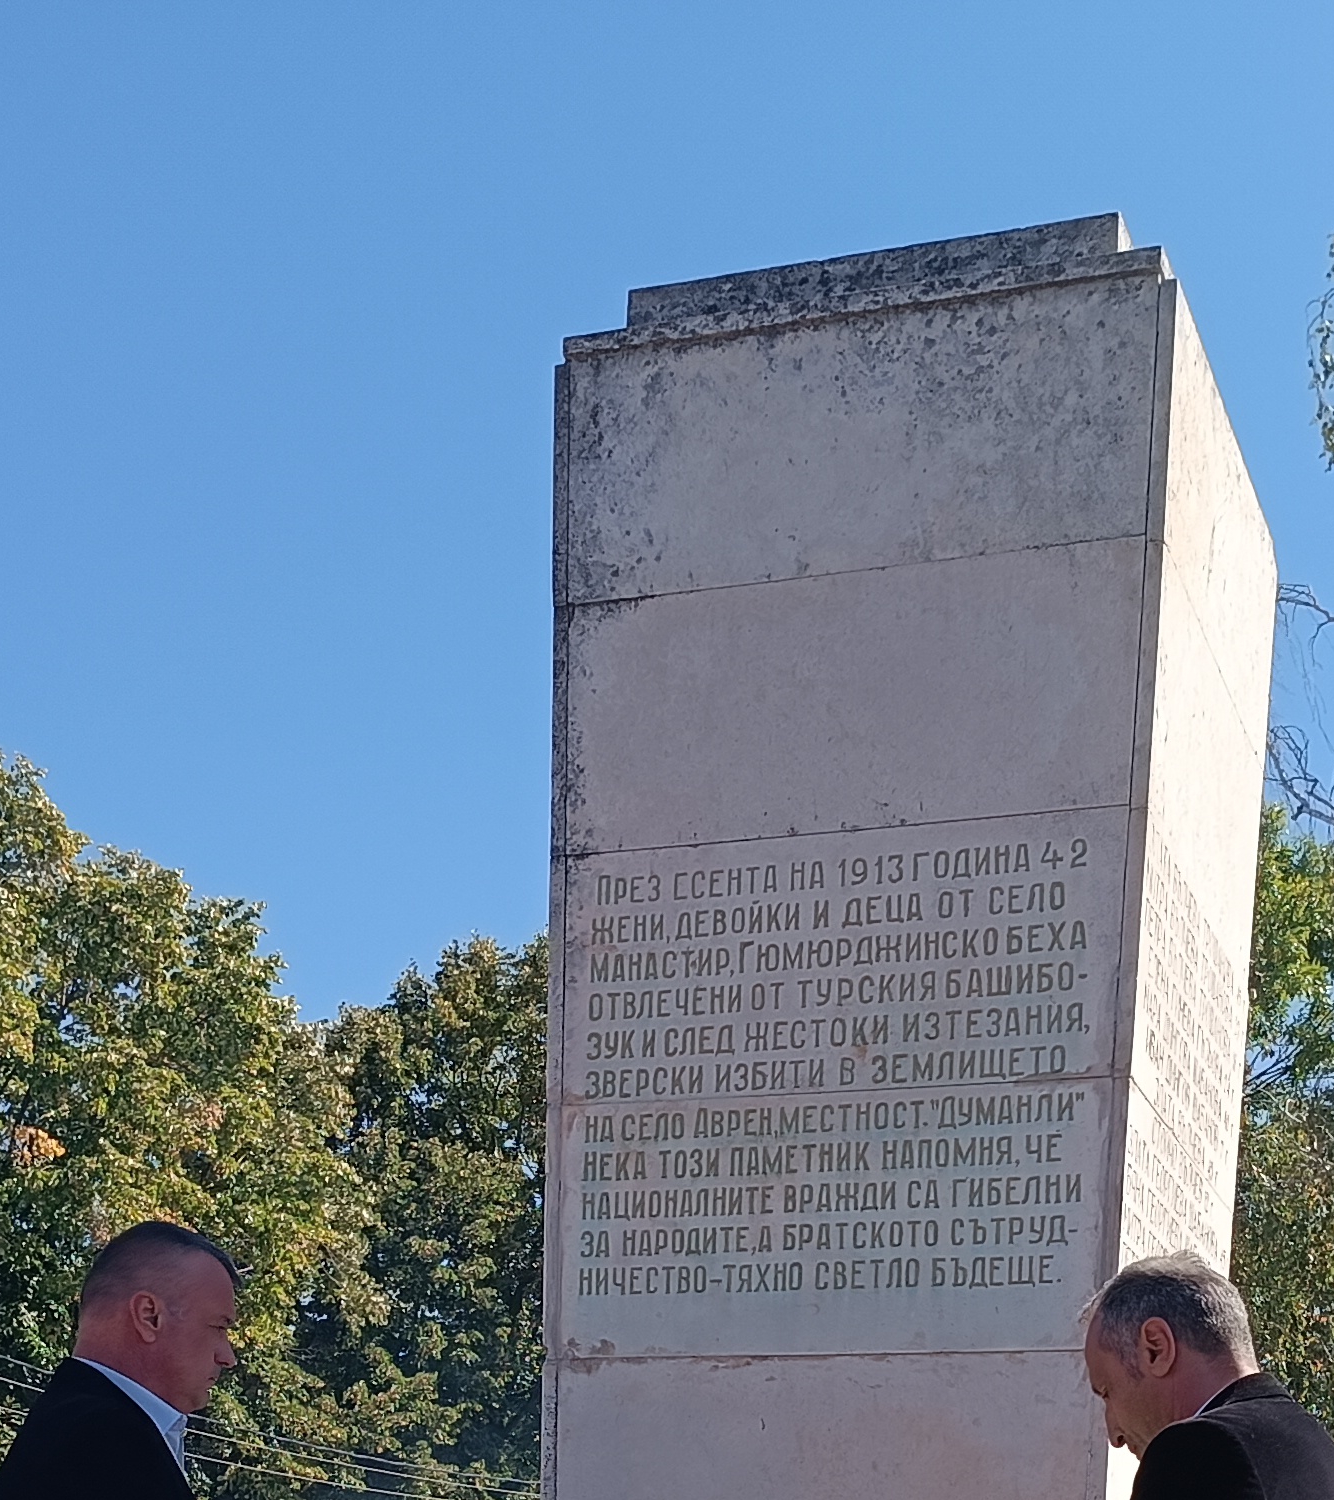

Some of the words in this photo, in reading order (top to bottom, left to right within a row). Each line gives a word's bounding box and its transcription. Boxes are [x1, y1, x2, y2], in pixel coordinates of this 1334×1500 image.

[597, 875, 661, 905] ПРЕЗ
[673, 864, 777, 901] ЕСЕНТА
[790, 861, 824, 891] НА
[838, 854, 904, 887] 1913
[912, 843, 1030, 882] ГОДИНА
[1040, 838, 1088, 870] 42
[812, 900, 829, 930] И
[841, 892, 924, 929] ДЕЦА
[938, 888, 974, 919] ОТ
[988, 881, 1066, 915] СЕЛО
[1006, 920, 1087, 956] БЕХА
[588, 983, 742, 1022] ОТВЛЕЧЕНИ
[751, 982, 785, 1012] ОТ
[798, 970, 936, 1009] ТУРСКИЯ
[945, 961, 1088, 999] БАШИБО-
[586, 1028, 635, 1061] ЗУК
[641, 1028, 656, 1058] И
[664, 1024, 736, 1057] СЛЕД
[743, 1014, 889, 1052] ЖЕСТОКИ
[902, 1002, 1090, 1042] ИЗТЕЗАНИЯ,
[585, 1064, 703, 1100] ЗВЕРСКИ
[714, 1058, 824, 1093] ИЗБИТИ
[839, 1056, 856, 1086] В
[871, 1044, 1066, 1084] ЗЕМЛИЩЕТО
[584, 1115, 614, 1143] НА
[620, 1112, 685, 1143] СЕЛО
[581, 1151, 648, 1182] НЕКА
[659, 1147, 720, 1180] ТОЗИ
[729, 1141, 870, 1178] ПАМЕТНИК
[882, 1135, 1020, 1171] НАПОМНЯ,
[1025, 1132, 1063, 1164] ЧЕ
[581, 1185, 775, 1222] НАЦИОНАЛНИТЕ
[783, 1181, 897, 1213] ВРАЖДИ
[907, 1179, 940, 1209] СА
[951, 1173, 1083, 1208] ГИБЕЛНИ
[580, 1230, 611, 1258] ЗА
[782, 1219, 939, 1252] БРАТСКОТО
[950, 1215, 1078, 1246] СЪТРУД-
[814, 1257, 920, 1291] СВЕТЛО
[930, 1254, 1062, 1289] БЪДЕЩЕ.
